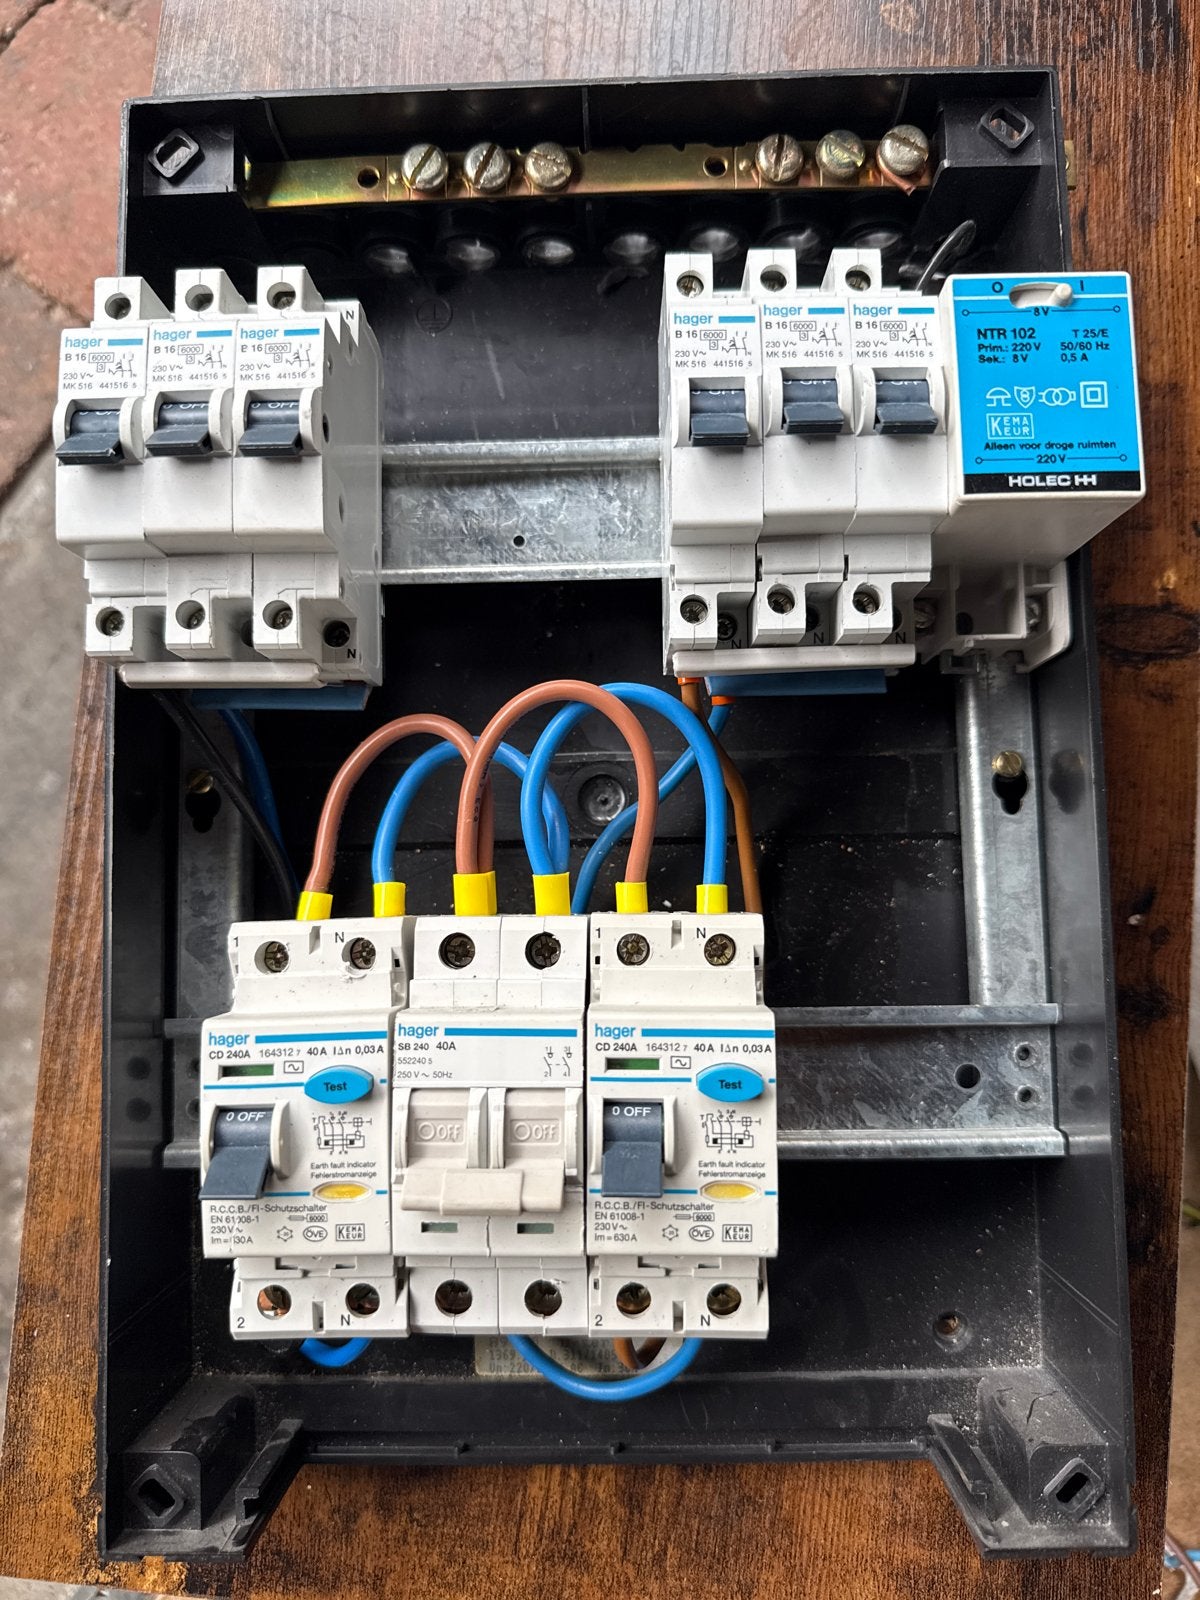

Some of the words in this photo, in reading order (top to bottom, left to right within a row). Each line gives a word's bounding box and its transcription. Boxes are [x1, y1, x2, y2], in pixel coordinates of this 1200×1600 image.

[346, 310, 354, 320] N
[763, 304, 803, 317] hager
[853, 304, 893, 317] hager
[673, 313, 713, 326] hager
[765, 322, 773, 330] B
[776, 321, 788, 329] 16
[855, 321, 863, 329] B
[866, 321, 878, 329] 16
[153, 330, 192, 341] hager
[240, 328, 279, 340] hager
[675, 330, 683, 339] B
[686, 330, 698, 339] 16
[703, 331, 723, 339] 6000
[977, 328, 1007, 340] NTR
[1010, 327, 1036, 340] 102
[1072, 330, 1079, 338] T
[1083, 329, 1109, 338] 25/E
[64, 336, 103, 349] hager
[1060, 341, 1093, 351] 50/60
[1096, 341, 1110, 351] Hz
[154, 346, 161, 354] B
[164, 345, 176, 353] 16
[241, 345, 248, 353] B
[252, 344, 263, 352] 16
[65, 353, 72, 361] B
[75, 353, 86, 361] 16
[1061, 353, 1077, 363] 0,5
[1080, 352, 1088, 362] A
[78, 382, 93, 390] 516
[99, 381, 128, 389] 441516
[984, 442, 1016, 450] Alleen
[1019, 442, 1041, 450] voor
[1045, 441, 1074, 451] droge
[1077, 441, 1116, 449] ruimten
[1009, 475, 1071, 488] HOLEC
[814, 632, 825, 644] N
[895, 632, 906, 644] N
[731, 640, 742, 650] N
[347, 648, 357, 659] N
[334, 931, 345, 943] N
[697, 927, 706, 939] N
[398, 1024, 439, 1039] hager
[594, 1024, 636, 1040] hager
[208, 1032, 250, 1047] hager
[398, 1043, 411, 1051] SB
[413, 1043, 429, 1051] 240
[595, 1043, 610, 1051] CD
[613, 1043, 637, 1051] 240A
[646, 1043, 680, 1052] 164312
[209, 1050, 224, 1060] CD
[226, 1049, 251, 1059] 240A
[260, 1048, 294, 1058] 164312
[397, 1071, 412, 1079] 250
[433, 1071, 453, 1079] 50Hz
[324, 1082, 347, 1092] Test
[719, 1080, 742, 1089] Test
[237, 1111, 266, 1121] OFF
[623, 1106, 652, 1117] OFF
[311, 1162, 329, 1170] Earth
[330, 1161, 345, 1169] fault
[347, 1161, 377, 1169] indicator
[718, 1160, 734, 1168] fault
[311, 1171, 377, 1179] Fehlerstromanzeige
[699, 1171, 766, 1179] Fehlerstromanzeige
[210, 1215, 223, 1224] EN
[595, 1211, 607, 1220] EN
[610, 1212, 645, 1221] 61008-1
[237, 1316, 245, 1329] 2
[341, 1314, 351, 1326] N
[595, 1315, 603, 1327] 2
[700, 1315, 710, 1327] N
